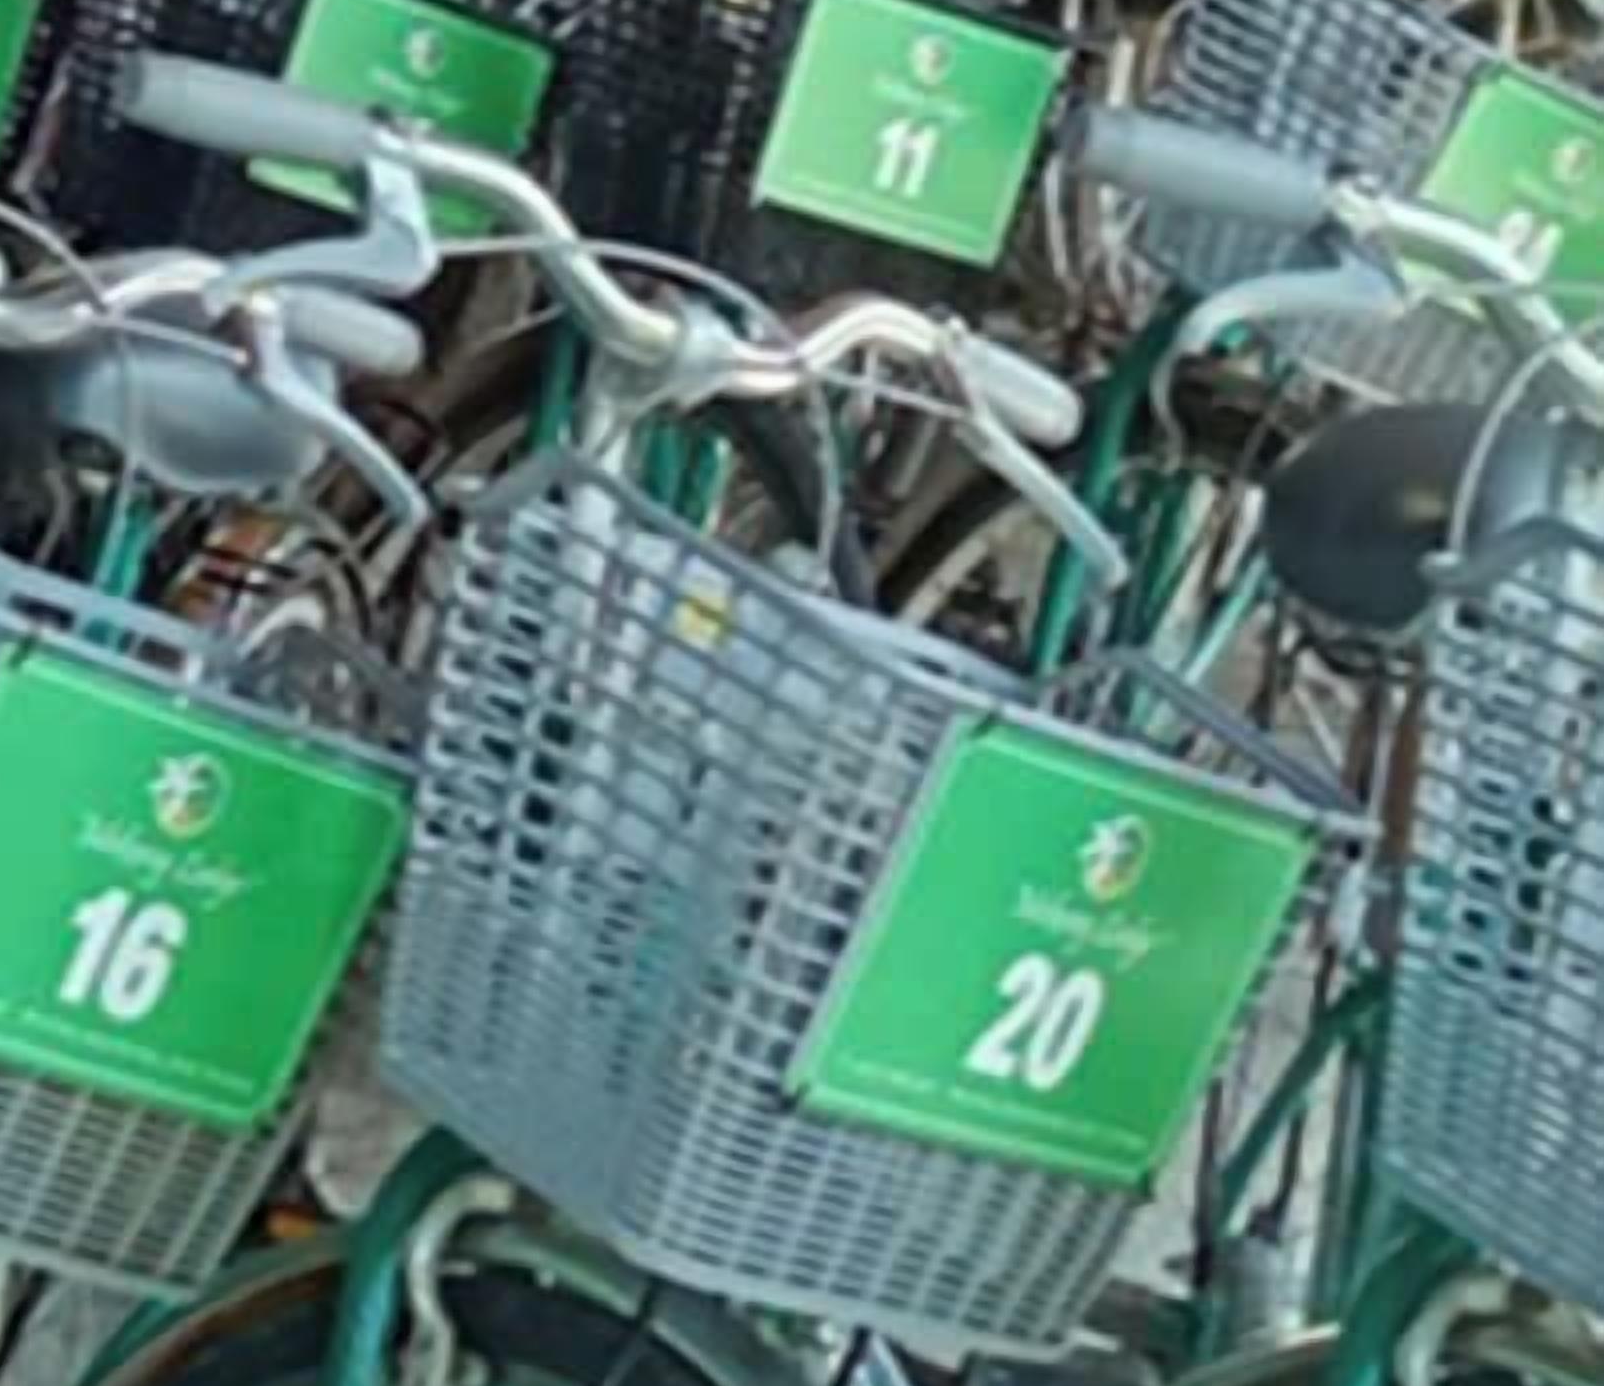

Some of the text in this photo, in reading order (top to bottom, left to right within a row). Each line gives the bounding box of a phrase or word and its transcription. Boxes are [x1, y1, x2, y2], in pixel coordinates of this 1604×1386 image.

[873, 116, 939, 200] 11
[58, 886, 189, 1024] 16
[962, 951, 1103, 1092] 20
